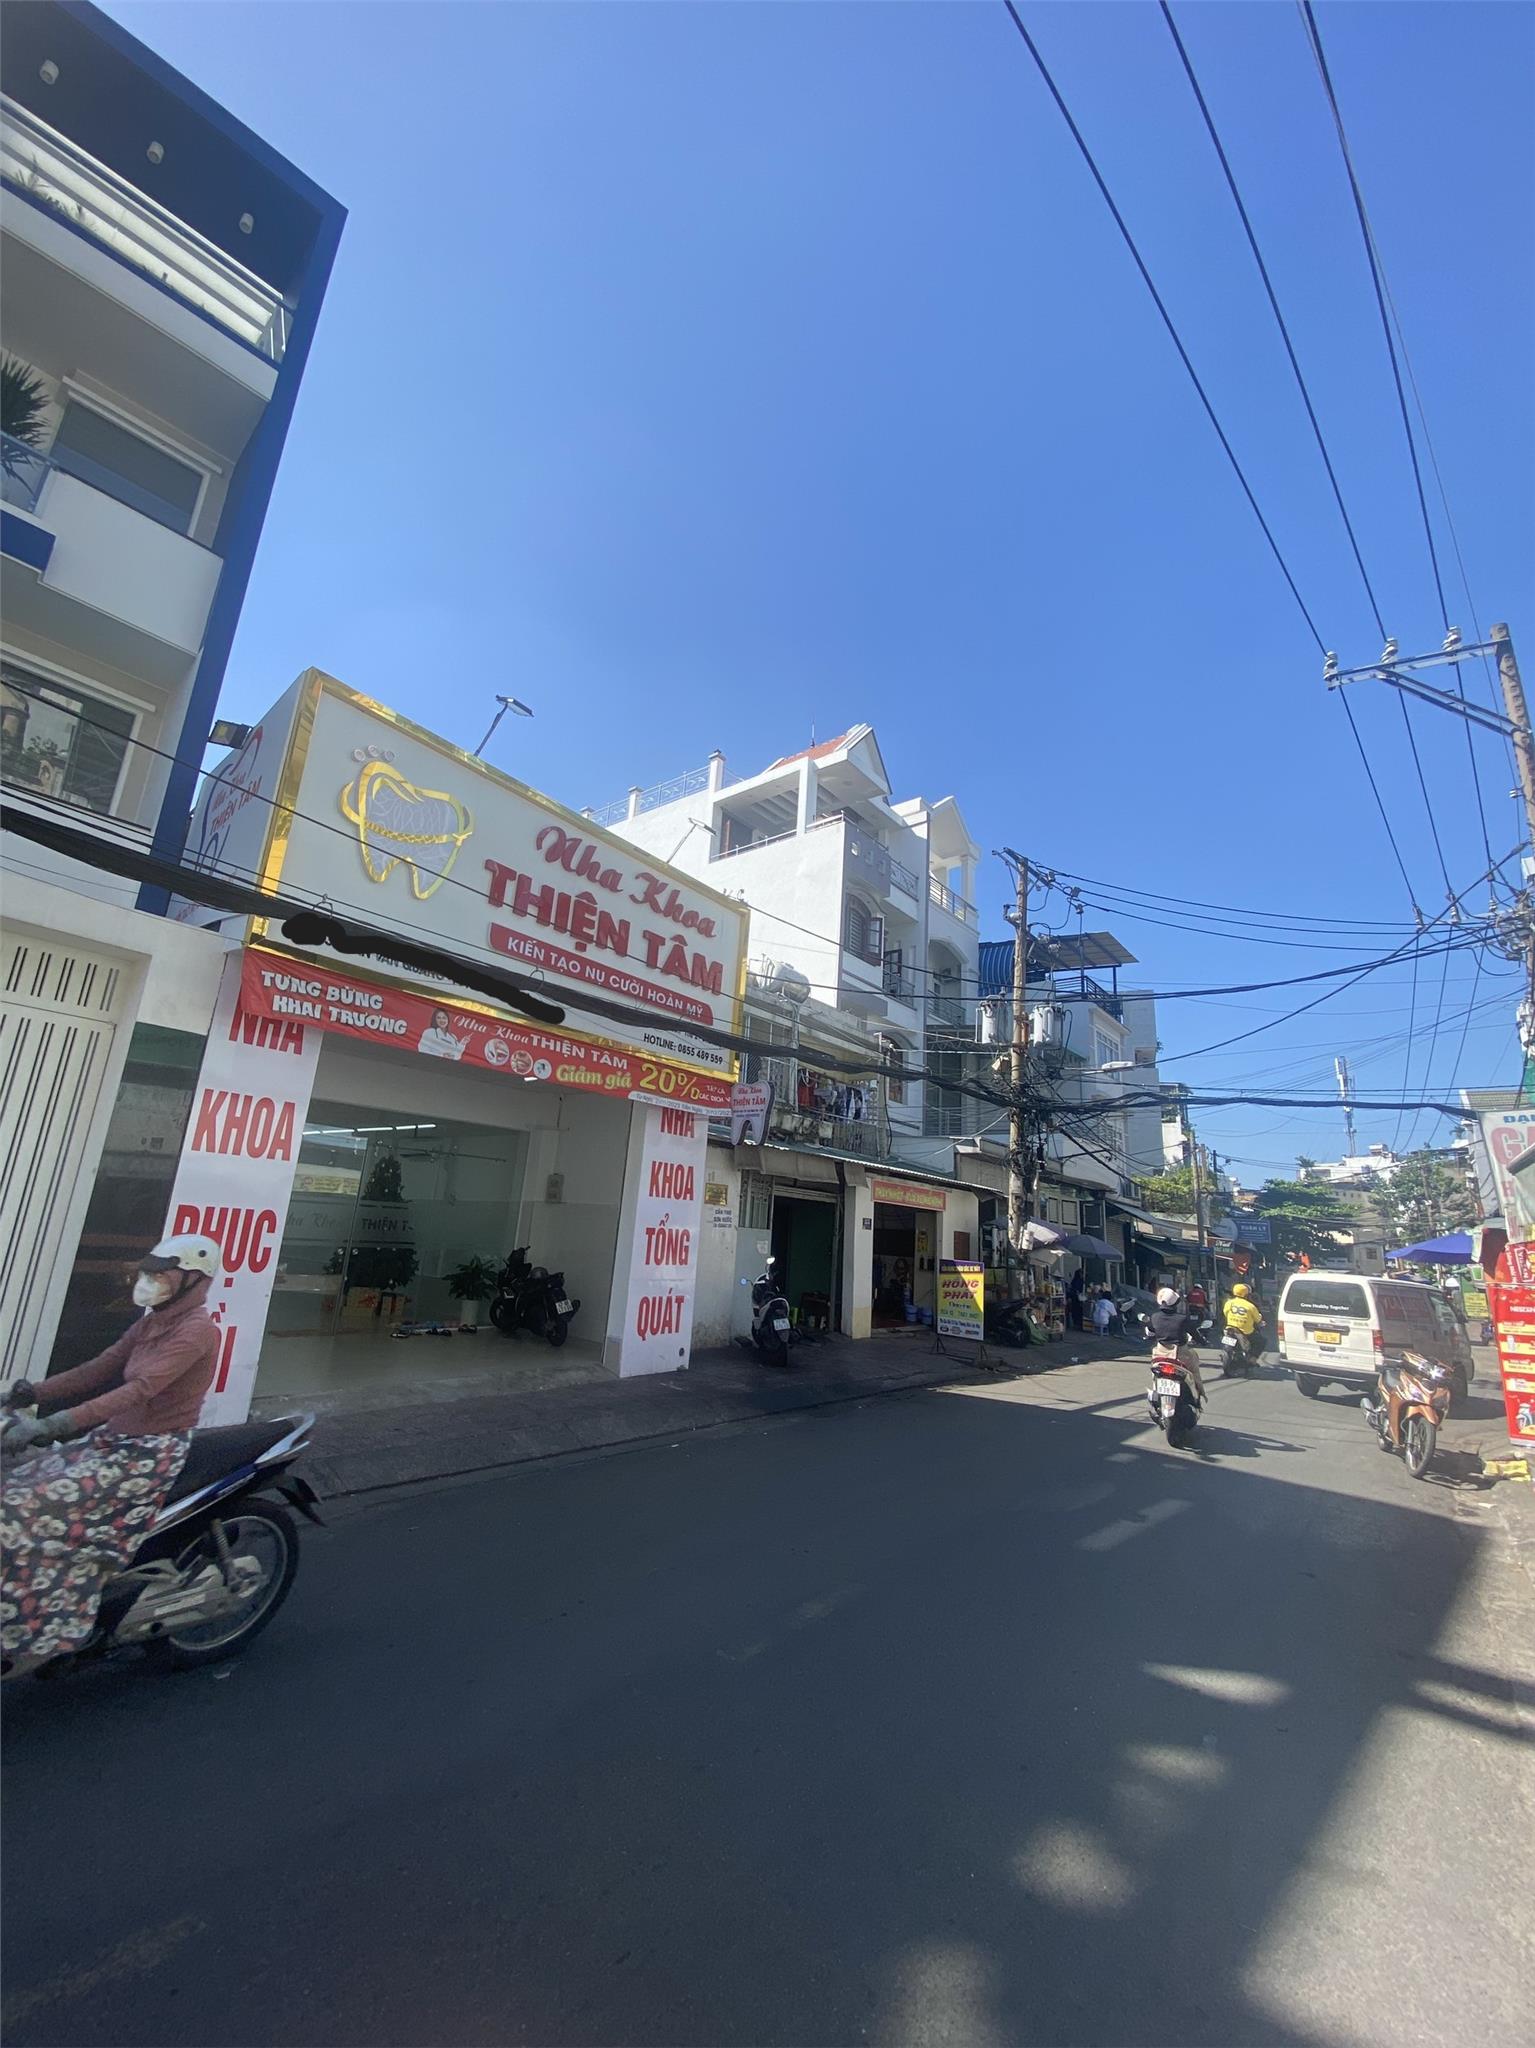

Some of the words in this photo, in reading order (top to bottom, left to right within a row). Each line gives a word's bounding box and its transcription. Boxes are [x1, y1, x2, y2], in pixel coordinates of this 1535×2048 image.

[536, 825, 623, 893] Nha
[628, 871, 717, 938] Khoa
[484, 858, 631, 958] THIỆN
[642, 929, 723, 996] TÂM
[550, 951, 581, 973] TẠO
[585, 964, 605, 984] NỤ
[647, 988, 683, 1010] HOÀN
[272, 995, 322, 1019] KHAI
[329, 1006, 408, 1035] TRƯƠNG
[453, 1015, 488, 1034] Nha
[494, 1025, 529, 1045] Khoa
[529, 1033, 585, 1060] THIỆN
[591, 1049, 628, 1070] TÂM
[643, 1032, 676, 1052] HOTLINE:
[677, 1043, 695, 1057] 0855
[696, 1051, 709, 1062] 489
[710, 1055, 723, 1066] 559
[556, 1063, 603, 1086] Giảm
[603, 1070, 633, 1090] giá
[639, 1062, 701, 1100] 20%
[191, 1088, 297, 1161] KHOA
[661, 1108, 695, 1138] NHA
[649, 1161, 694, 1201] KHOA
[645, 1212, 691, 1266] TỔNG
[637, 1287, 684, 1341] QUÁT
